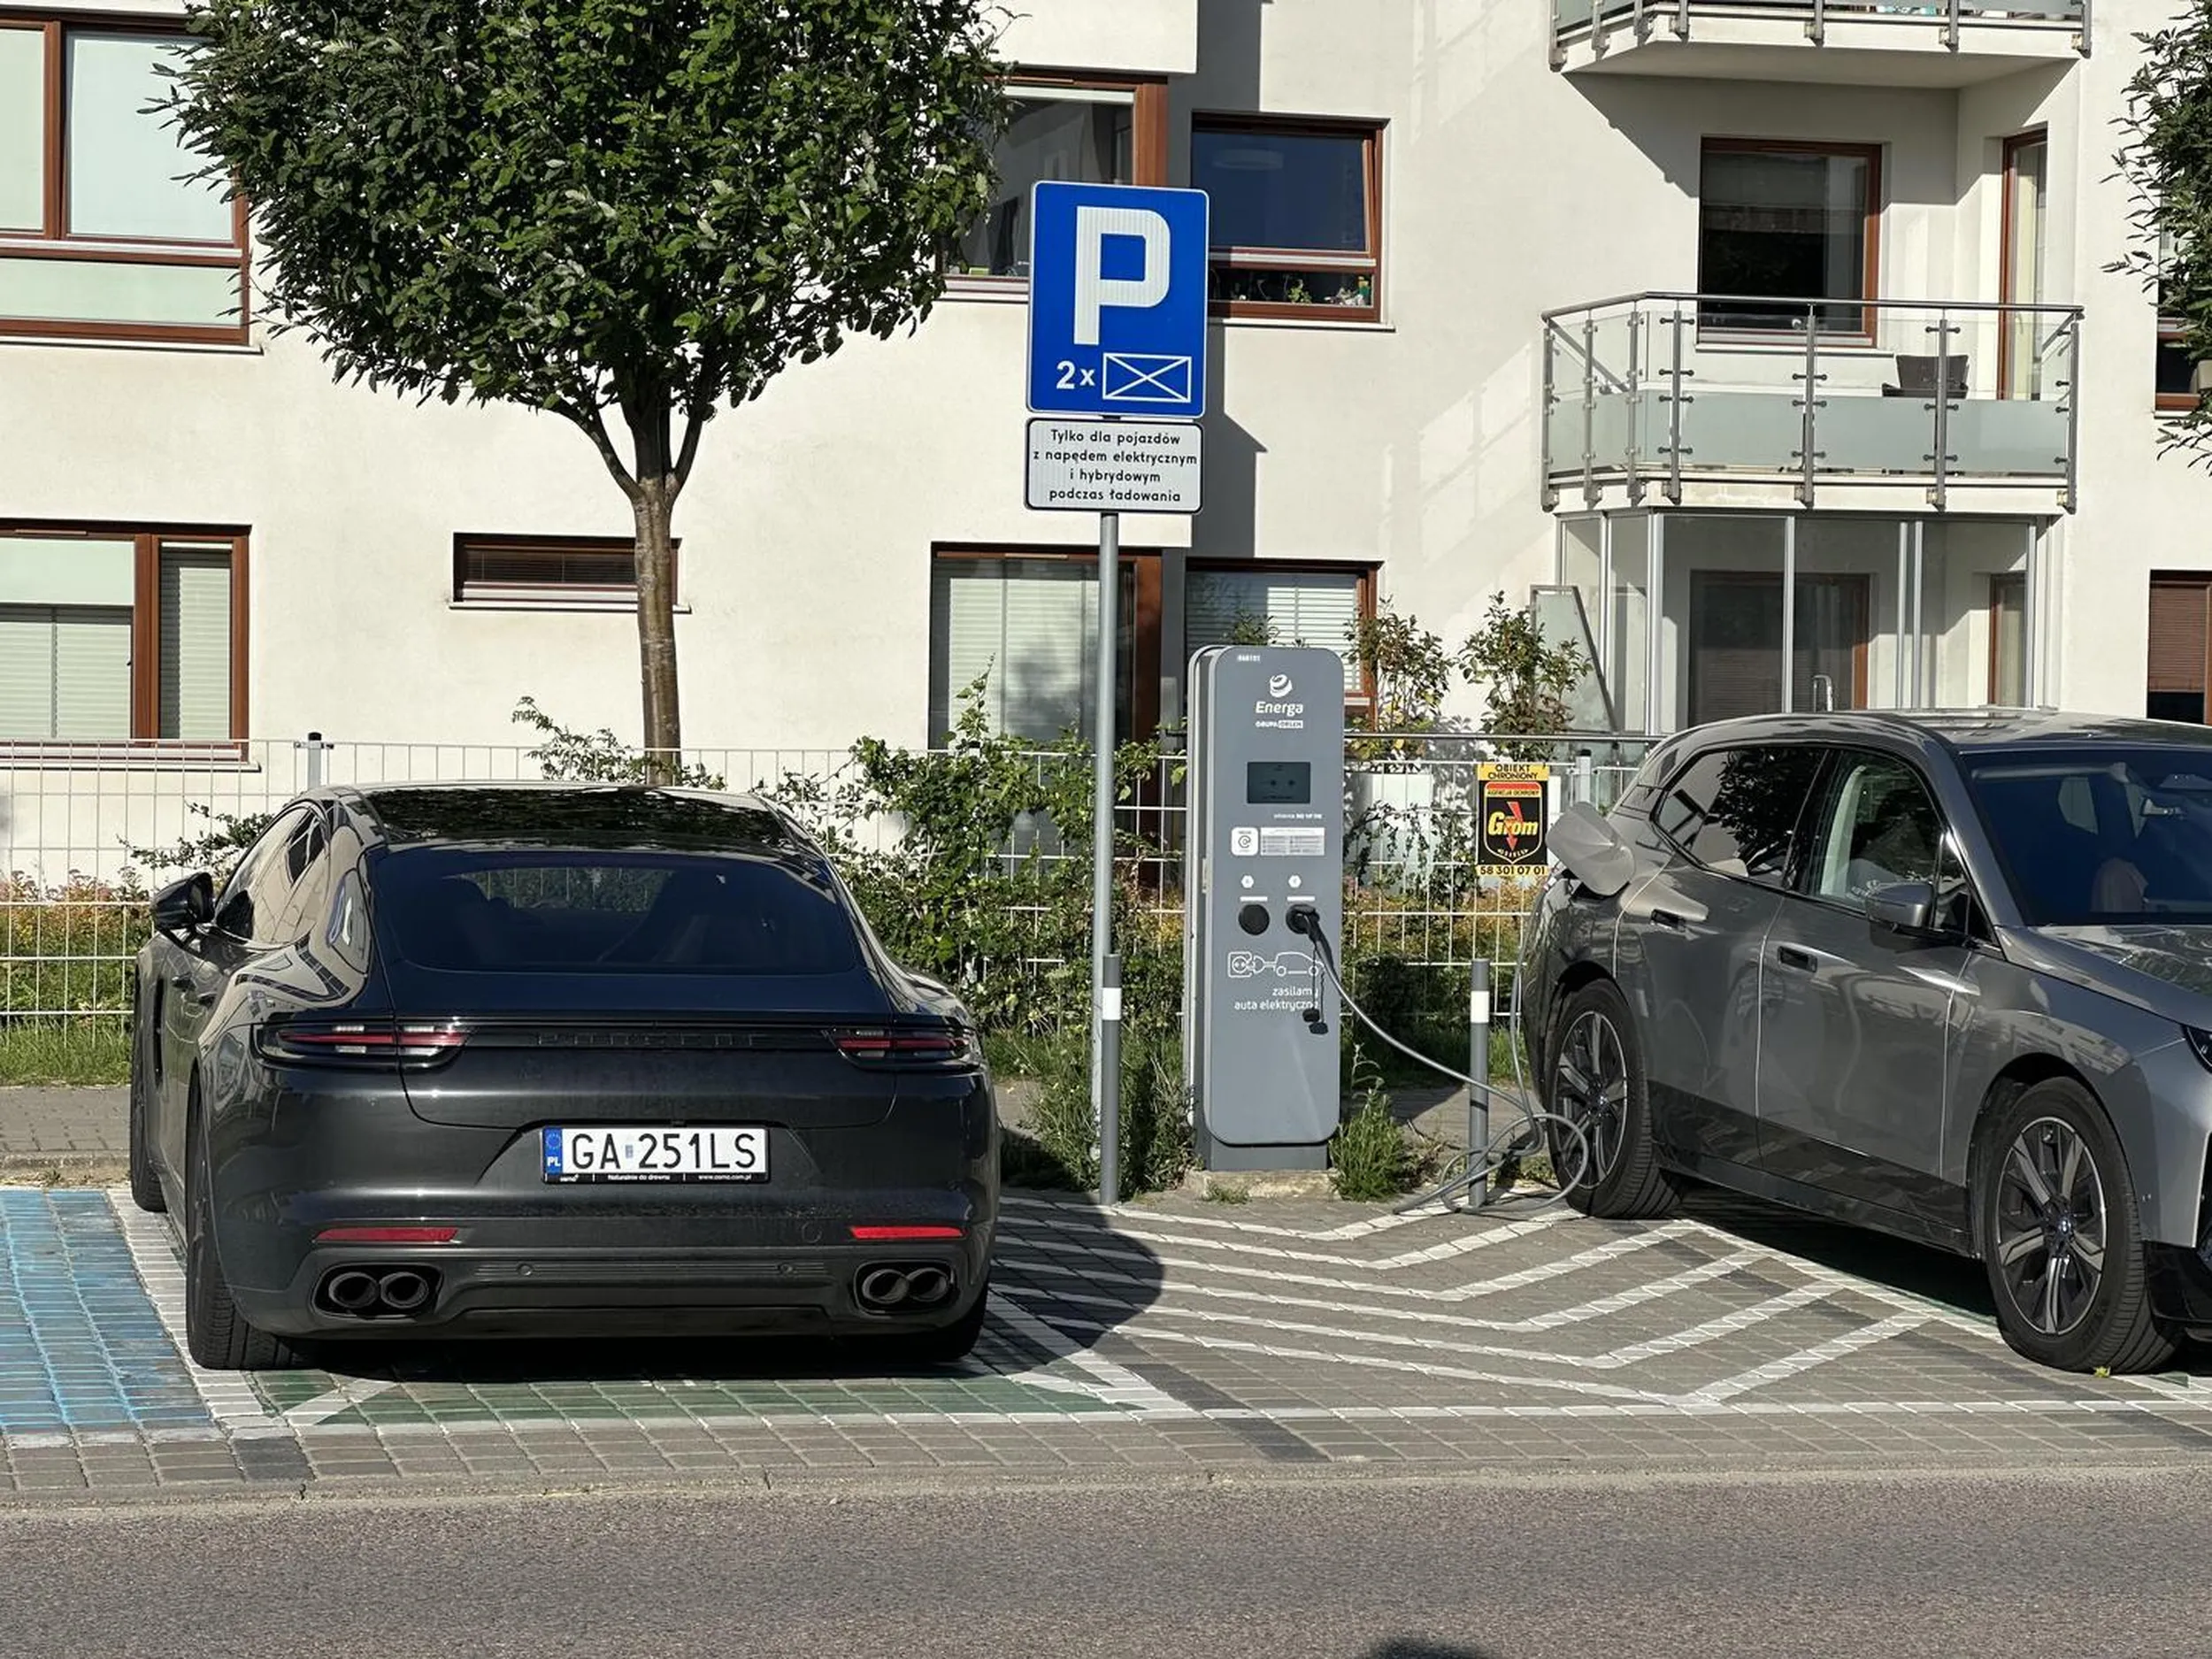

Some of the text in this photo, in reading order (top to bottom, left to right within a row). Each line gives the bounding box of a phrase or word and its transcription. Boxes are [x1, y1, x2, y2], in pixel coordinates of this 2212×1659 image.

[1073, 205, 1171, 345] P
[1051, 428, 1181, 447] Tylko dla pojazdów
[1033, 449, 1198, 467] z napędem elektrycznym
[1070, 468, 1161, 485] i hybrydowym
[1049, 488, 1181, 503] podczas ładowania
[1255, 701, 1303, 718] Energa
[1487, 811, 1539, 836] Grom
[1480, 866, 1545, 875] 58 301 07 01
[1234, 1001, 1257, 1010] auta
[547, 1133, 756, 1170] PL GA 251LS
